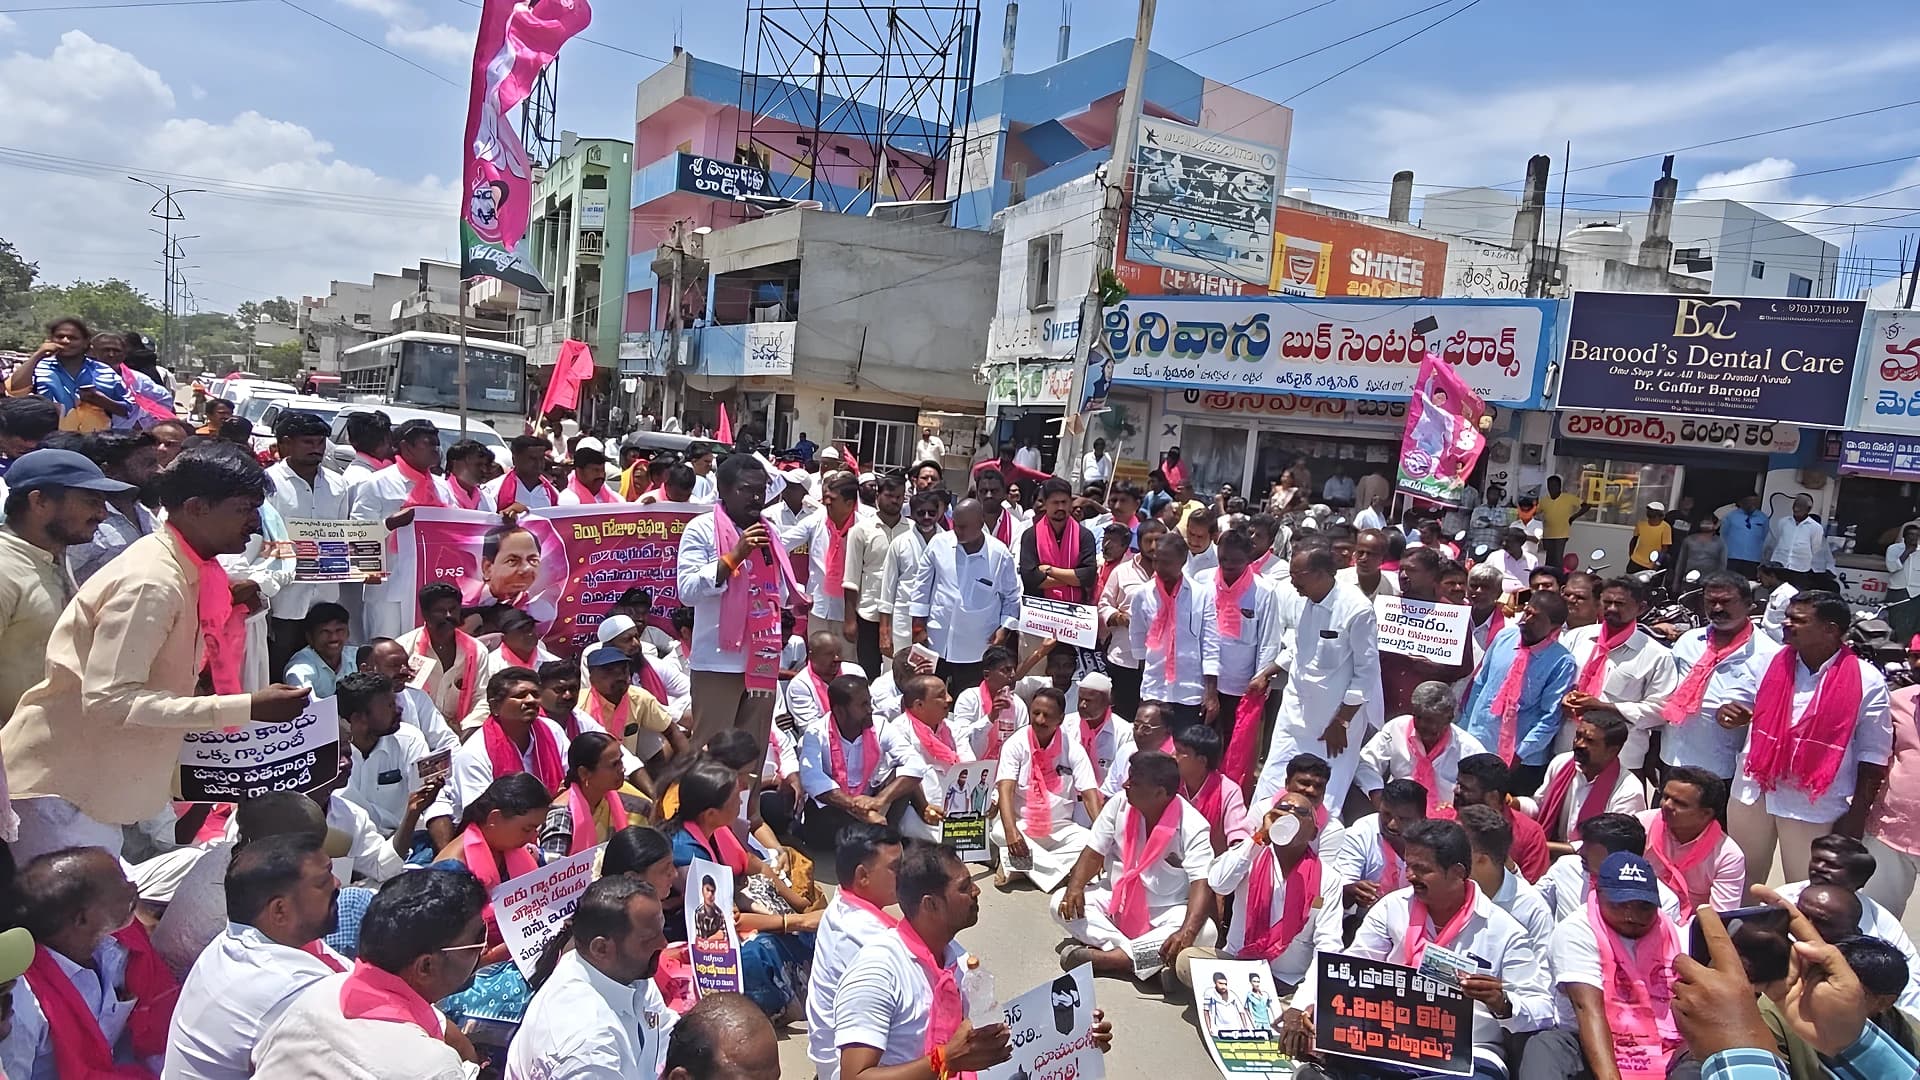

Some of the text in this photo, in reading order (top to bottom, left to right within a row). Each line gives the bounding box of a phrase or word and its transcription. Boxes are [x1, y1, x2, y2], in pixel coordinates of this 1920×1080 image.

[1160, 267, 1247, 296] CEMENT
[1350, 248, 1425, 287] SHREE
[1103, 304, 1271, 361] శ్రీనివాస
[1282, 323, 1333, 360] బుక్
[1338, 327, 1426, 363] సెంటర్
[1443, 327, 1521, 377] జిరాక్స్
[1570, 339, 1845, 374] Barood's Dental Care
[1634, 380, 1654, 391] Dr.
[1709, 385, 1761, 397] Barood
[184, 730, 249, 743] అమలు
[196, 750, 231, 764] ఒక్క
